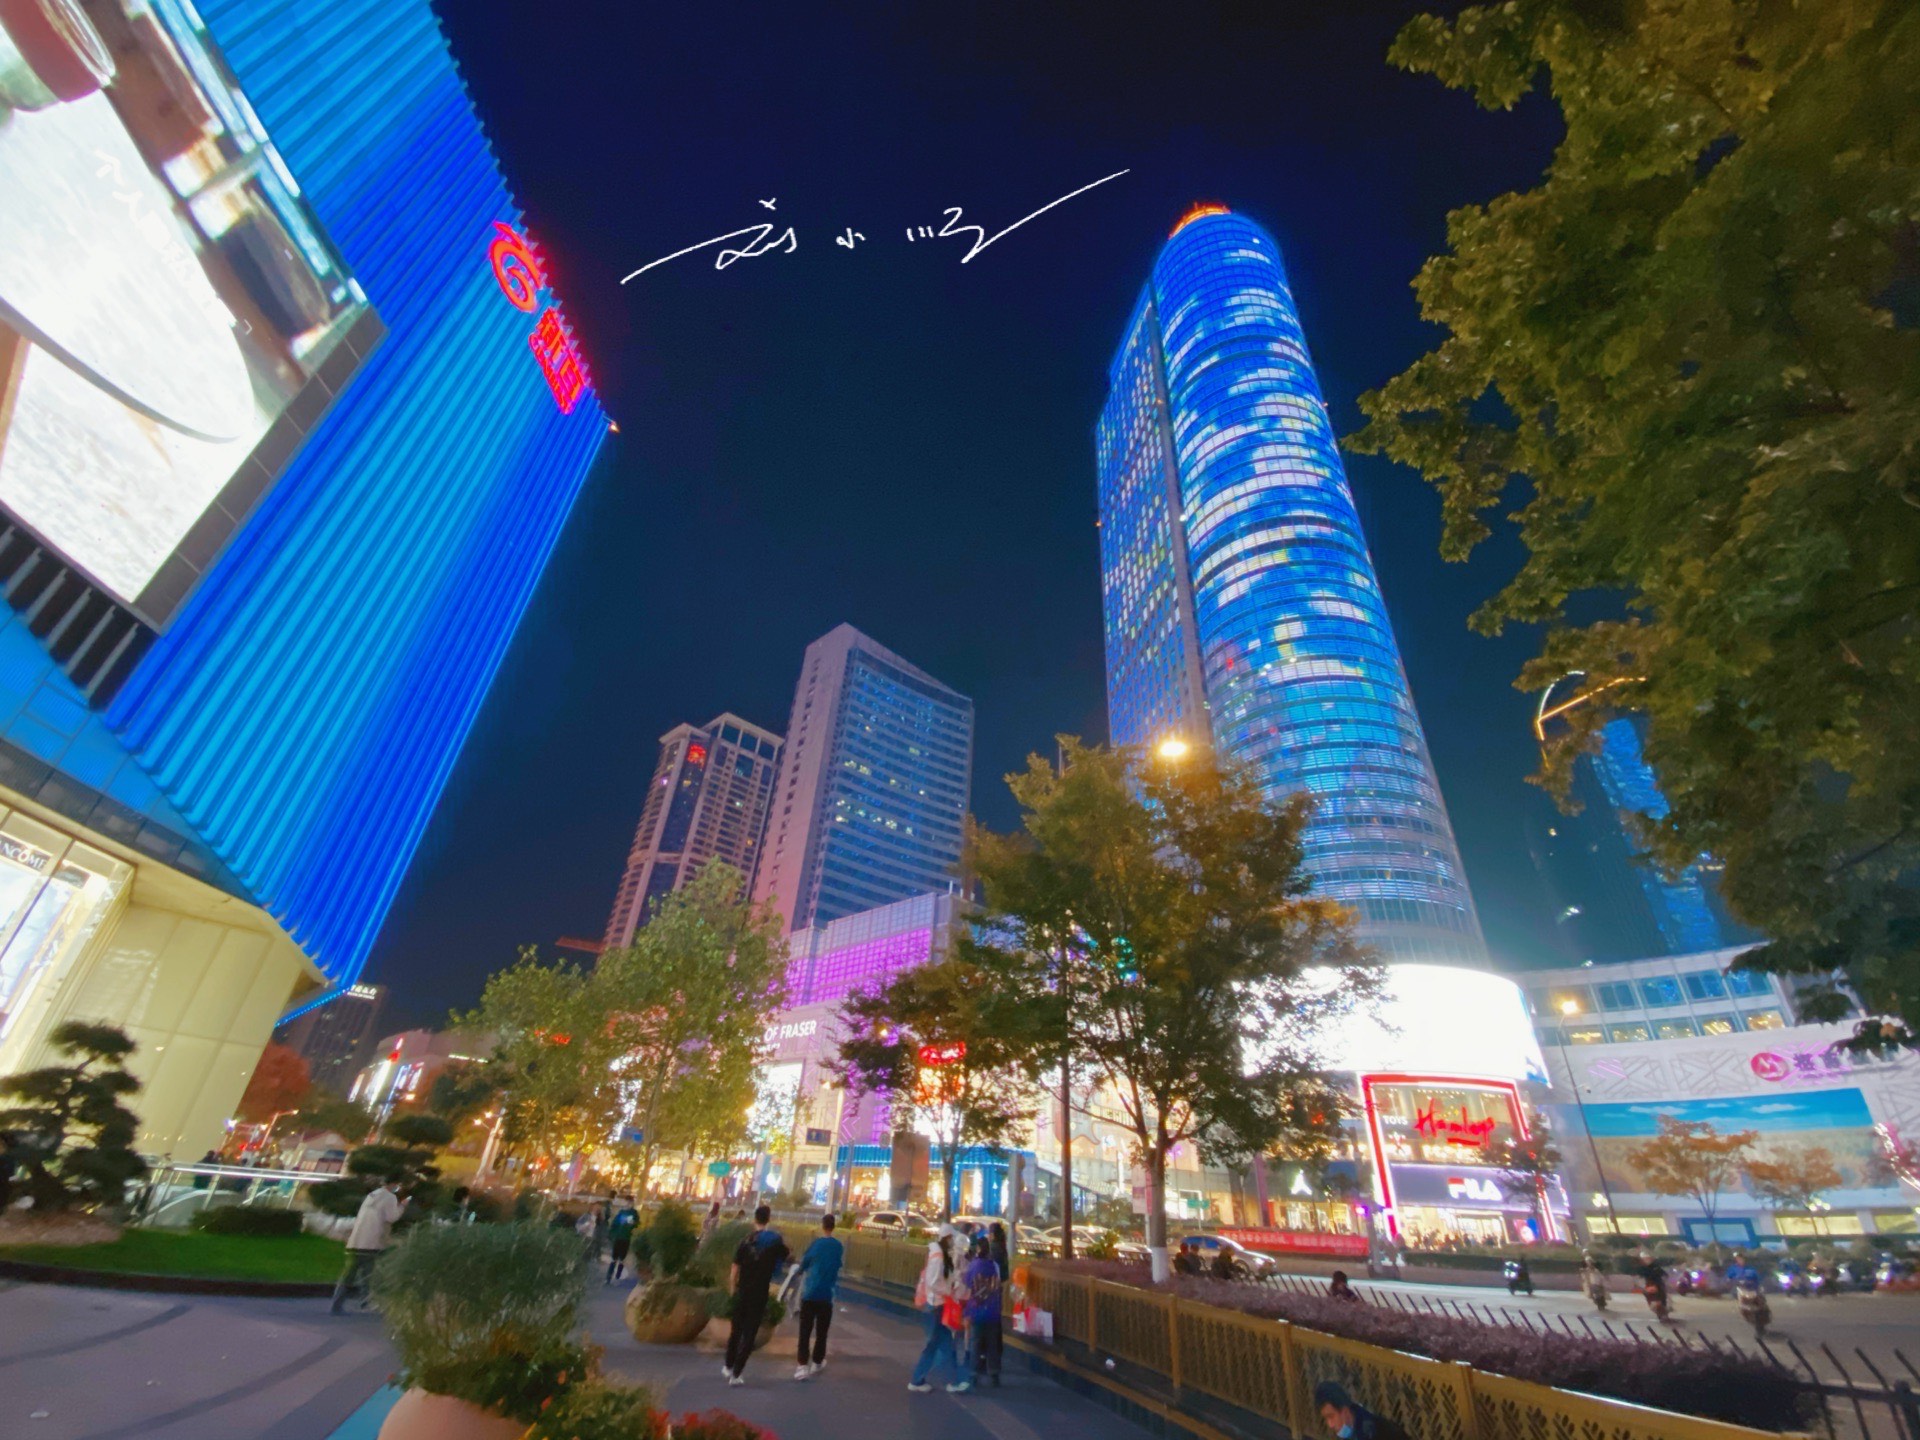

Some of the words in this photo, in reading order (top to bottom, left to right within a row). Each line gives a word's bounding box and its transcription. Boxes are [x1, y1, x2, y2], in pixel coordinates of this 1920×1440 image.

[763, 1026, 779, 1042] OF
[780, 1019, 817, 1040] FRASER
[1382, 1115, 1408, 1126] TOYS
[1447, 1177, 1503, 1201] FILA
